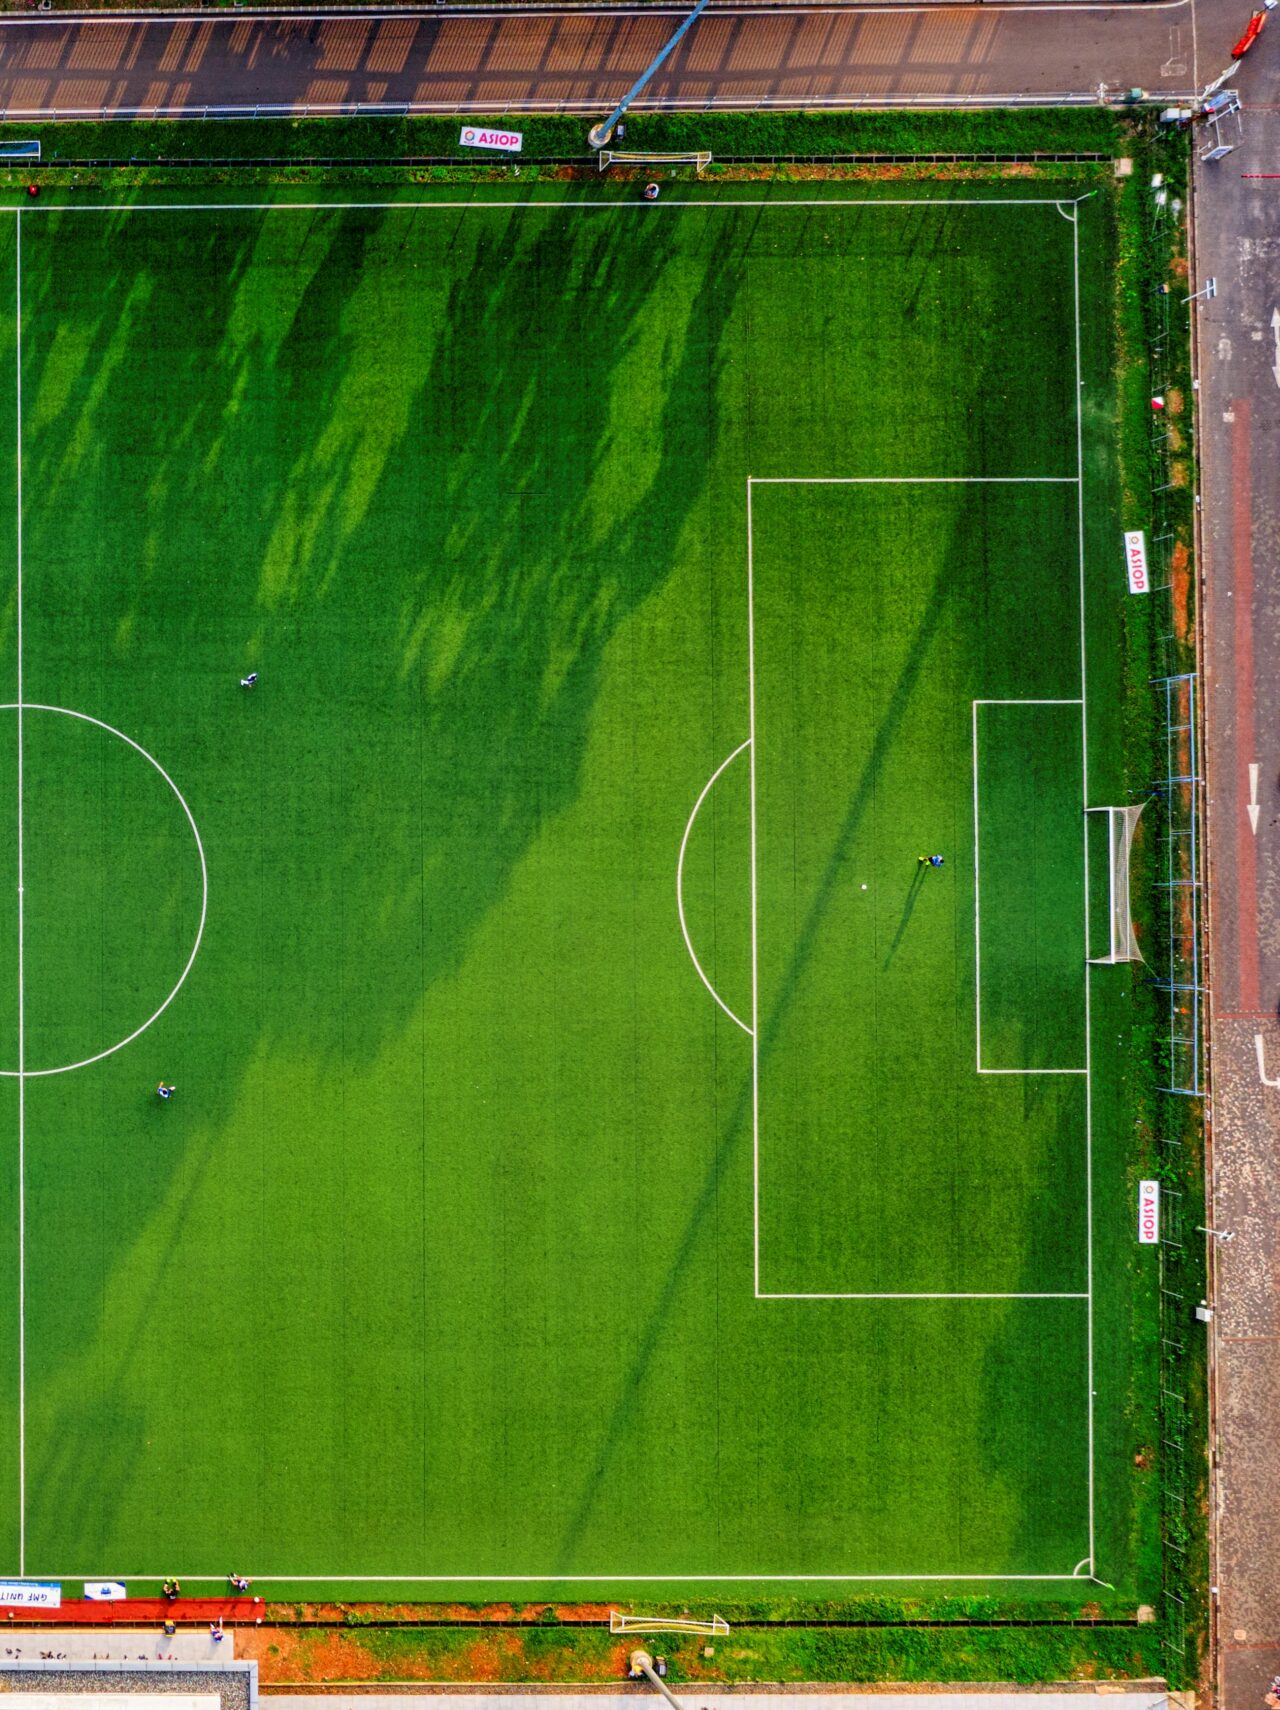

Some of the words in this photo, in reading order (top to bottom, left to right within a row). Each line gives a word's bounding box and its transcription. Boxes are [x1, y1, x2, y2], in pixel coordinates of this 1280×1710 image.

[479, 132, 519, 146] ASIOP
[1129, 548, 1145, 589] ASIOP
[1143, 1198, 1155, 1239] ASIOP
[27, 1592, 48, 1602] GMF
